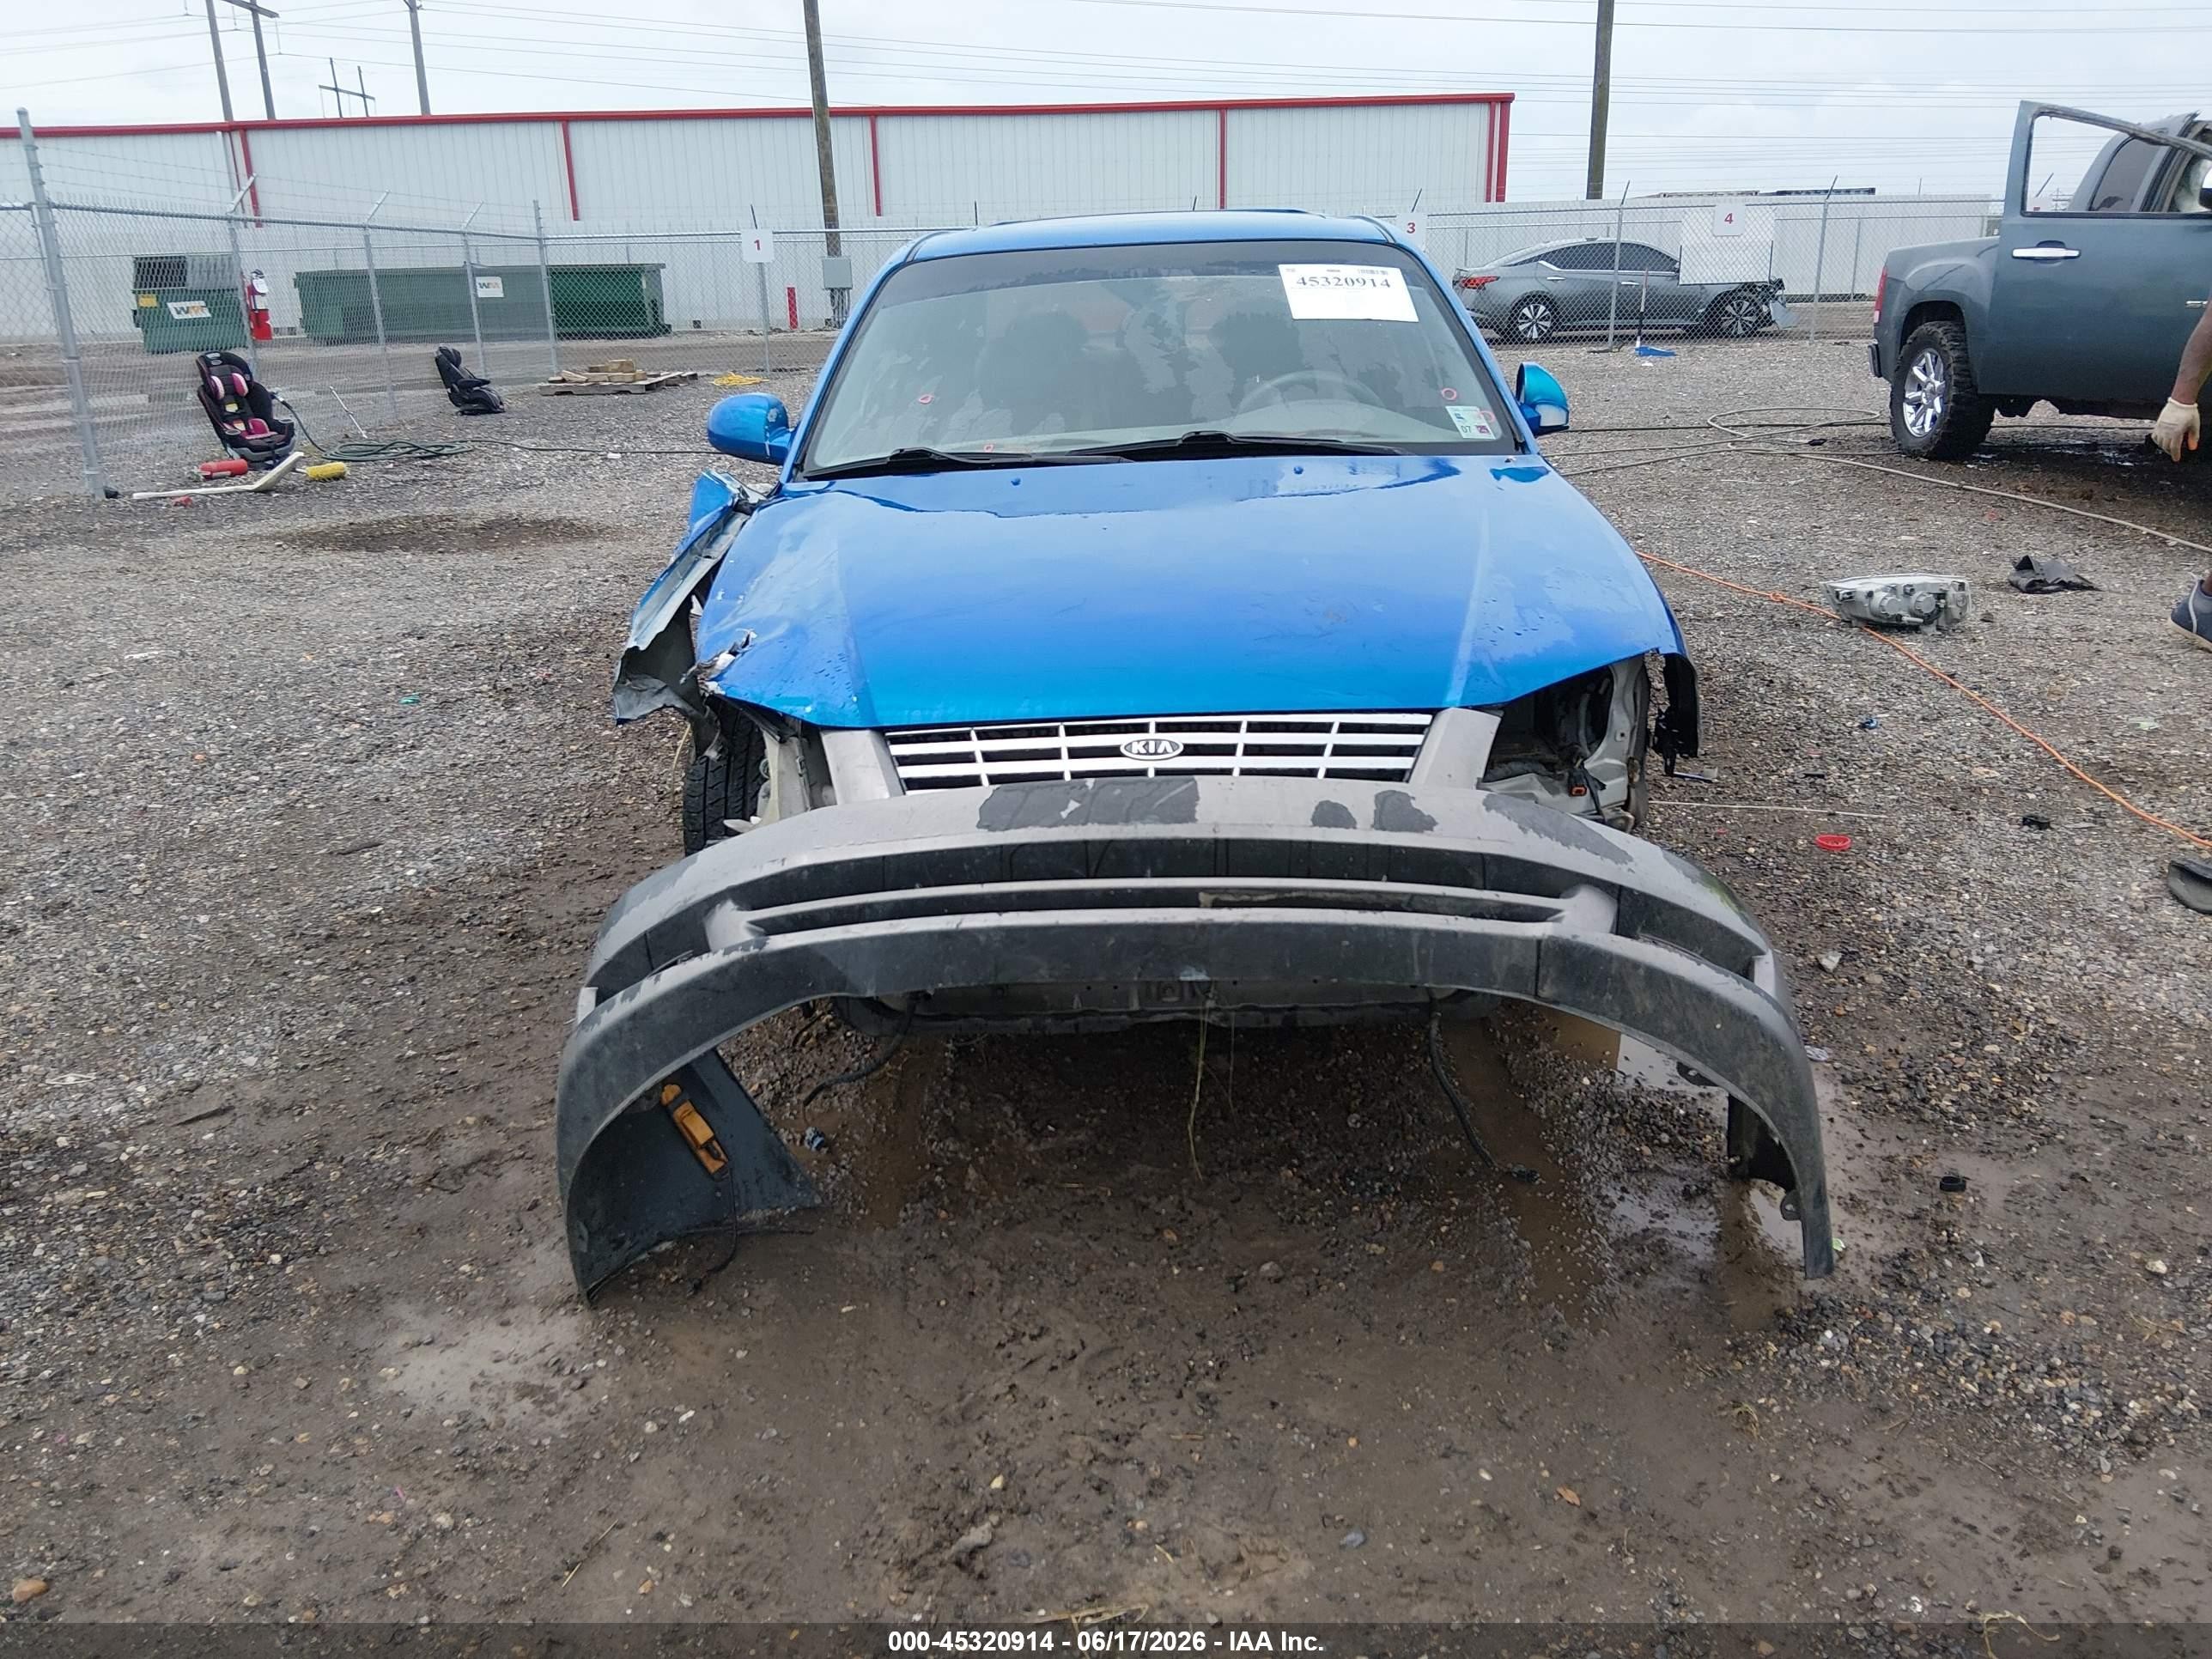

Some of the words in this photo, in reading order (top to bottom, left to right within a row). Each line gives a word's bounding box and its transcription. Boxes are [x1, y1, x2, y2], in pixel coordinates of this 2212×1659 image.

[1724, 212, 1733, 224] 4
[1407, 222, 1415, 234] 3
[754, 240, 760, 250] 1
[1296, 276, 1391, 289] 45320914
[1131, 740, 1174, 754] KIA
